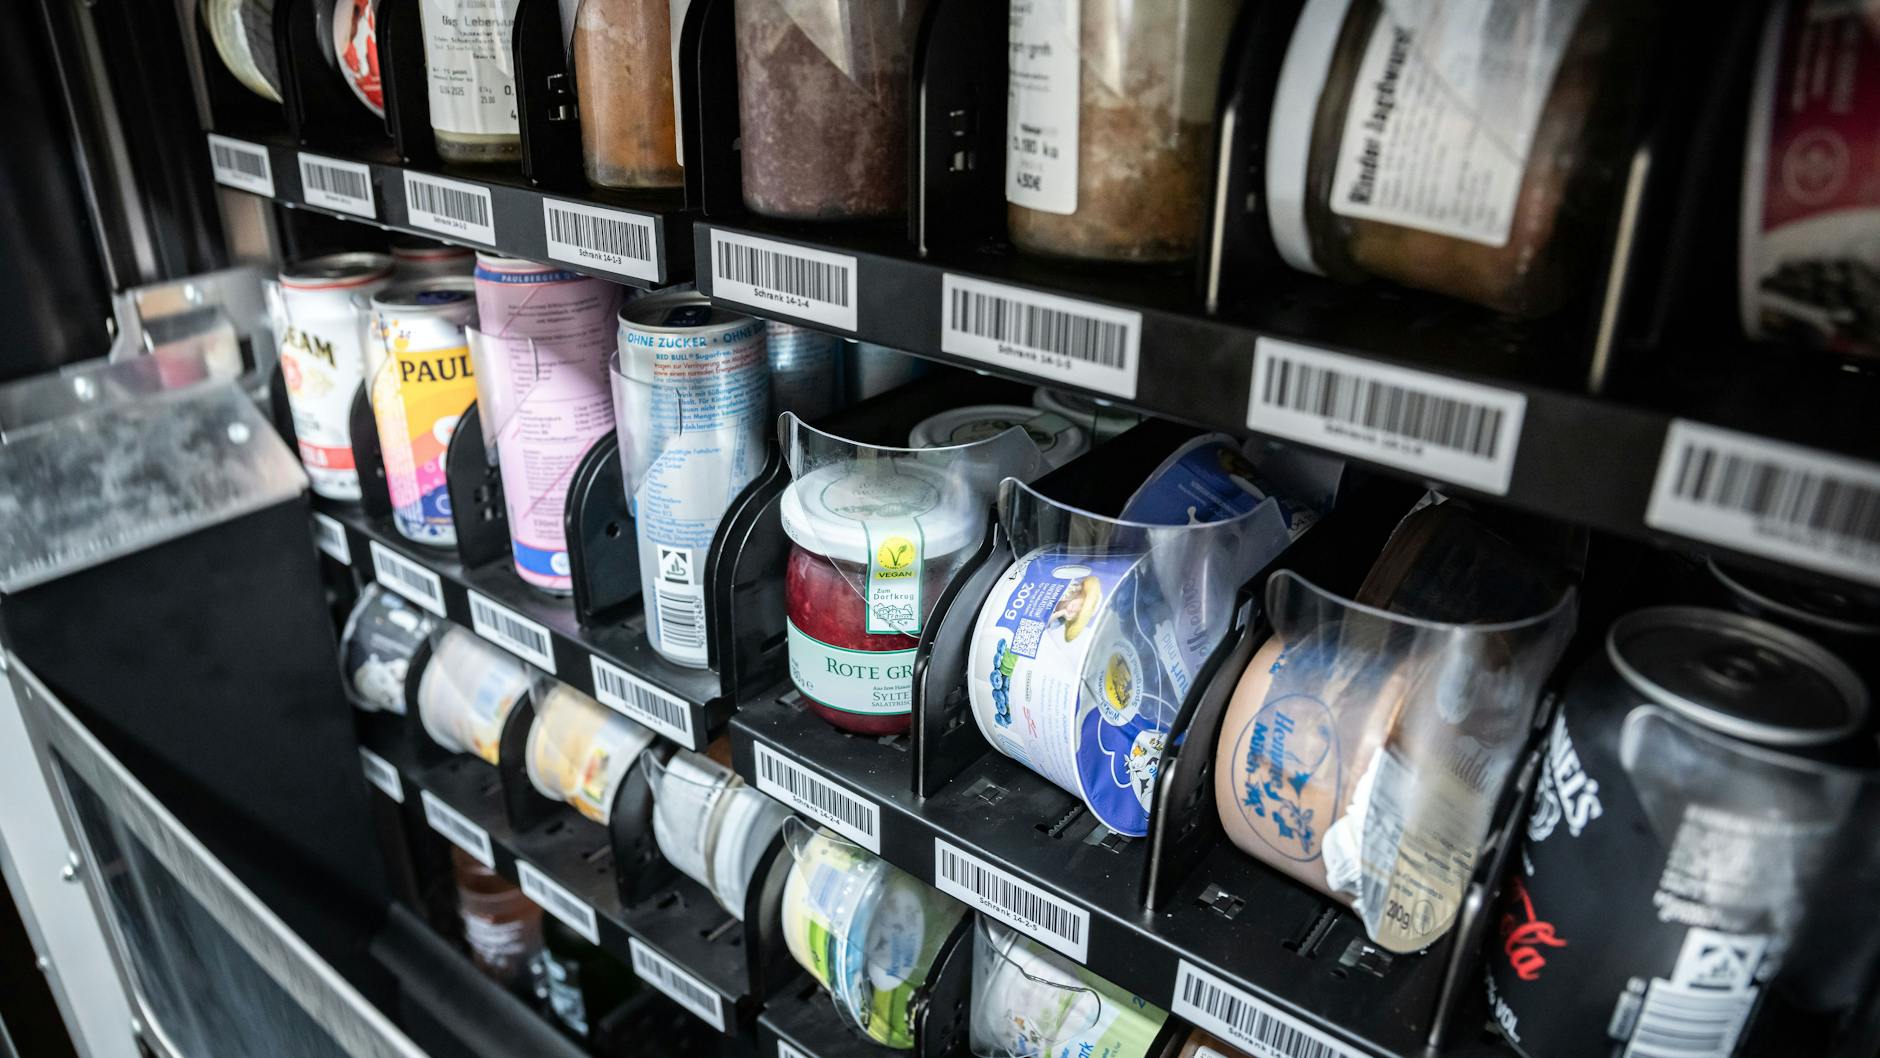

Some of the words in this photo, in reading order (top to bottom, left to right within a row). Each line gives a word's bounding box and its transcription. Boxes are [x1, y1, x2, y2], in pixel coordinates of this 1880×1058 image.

[579, 248, 602, 263] Schrank
[603, 253, 622, 265] 14-1-3
[753, 288, 784, 303] Schrank
[785, 295, 810, 308] 14-1-4
[283, 326, 336, 368] EAM
[627, 333, 653, 348] OHNE
[658, 337, 708, 348] ZUCKER
[873, 593, 914, 601] Dorfkrug
[825, 657, 880, 680] ROTE
[873, 691, 912, 701] SYLTE
[793, 795, 818, 813] Schrank
[820, 810, 840, 825] 14-2-4
[979, 897, 1011, 919] Schrank
[1012, 912, 1038, 931] 14-2-5
[1228, 1027, 1267, 1051] Schrank
